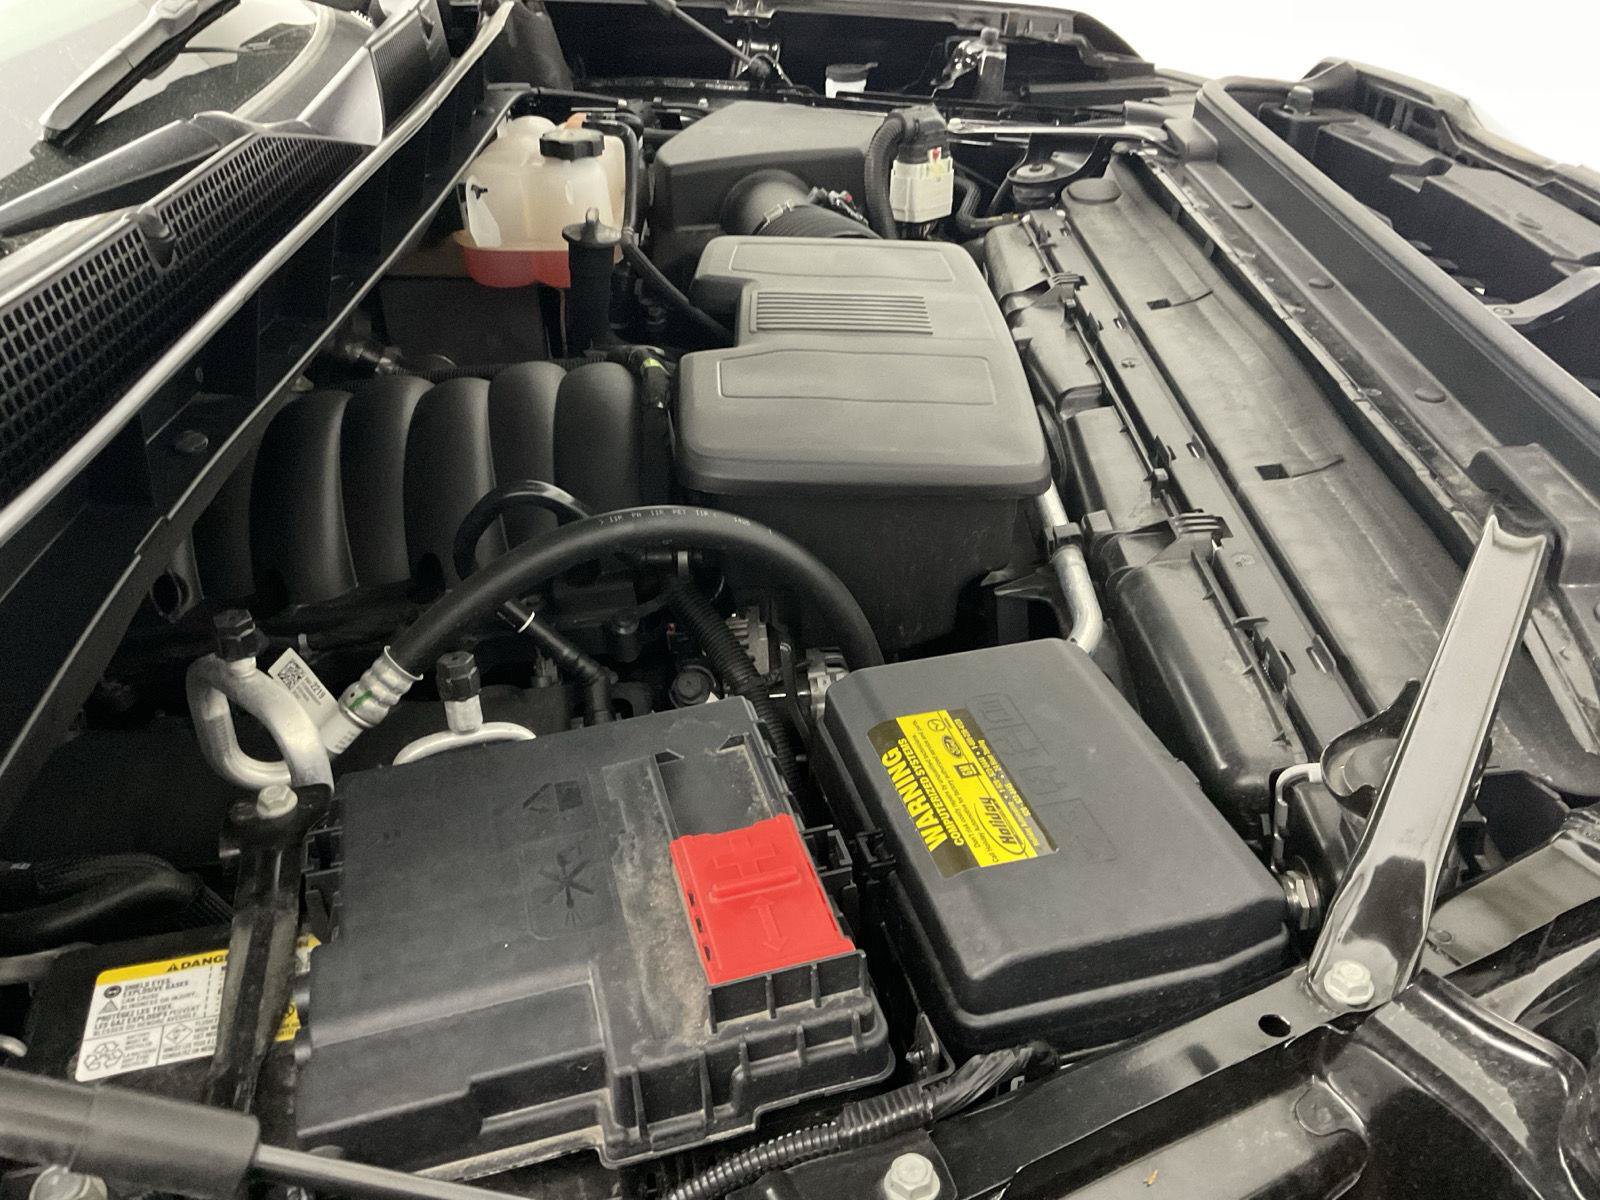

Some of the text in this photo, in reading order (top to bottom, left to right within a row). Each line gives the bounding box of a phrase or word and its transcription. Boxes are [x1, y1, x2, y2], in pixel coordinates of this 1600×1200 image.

[310, 680, 326, 699] 2219
[897, 737, 926, 777] SYSTEMS
[881, 746, 948, 852] WARNING
[919, 776, 965, 846] COMPUTERIZED
[978, 796, 1018, 845] Holiday
[967, 833, 981, 848] Don't
[123, 979, 188, 998] EXPLOSIVE GASES
[151, 976, 170, 986] EYES
